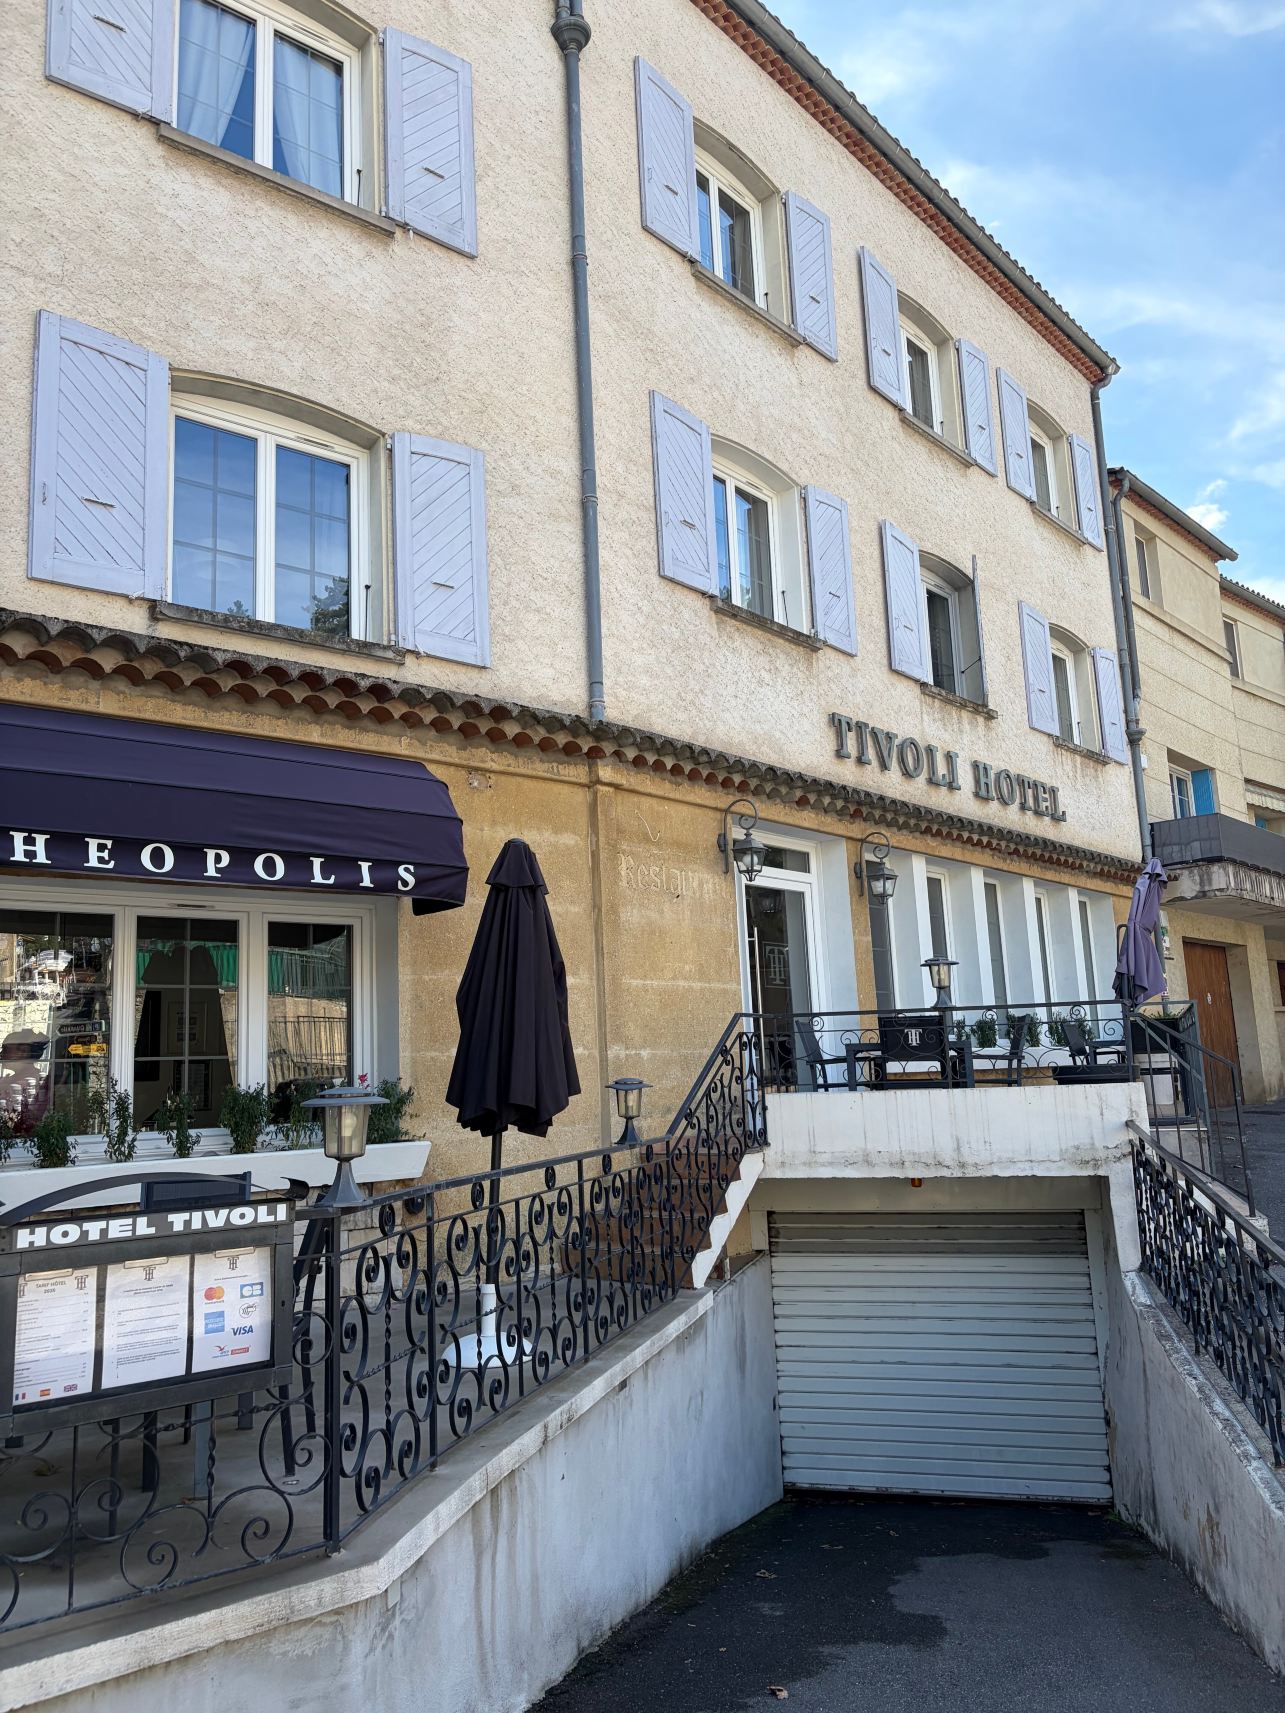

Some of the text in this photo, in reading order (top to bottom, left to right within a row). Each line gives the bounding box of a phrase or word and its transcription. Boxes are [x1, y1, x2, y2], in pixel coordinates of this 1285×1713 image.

[829, 712, 1067, 822] TIVOLI HOTEL
[9, 831, 416, 891] HEOPOLIS
[16, 1203, 287, 1249] HOTEL TIVOLI
[231, 1324, 254, 1337] VISA
